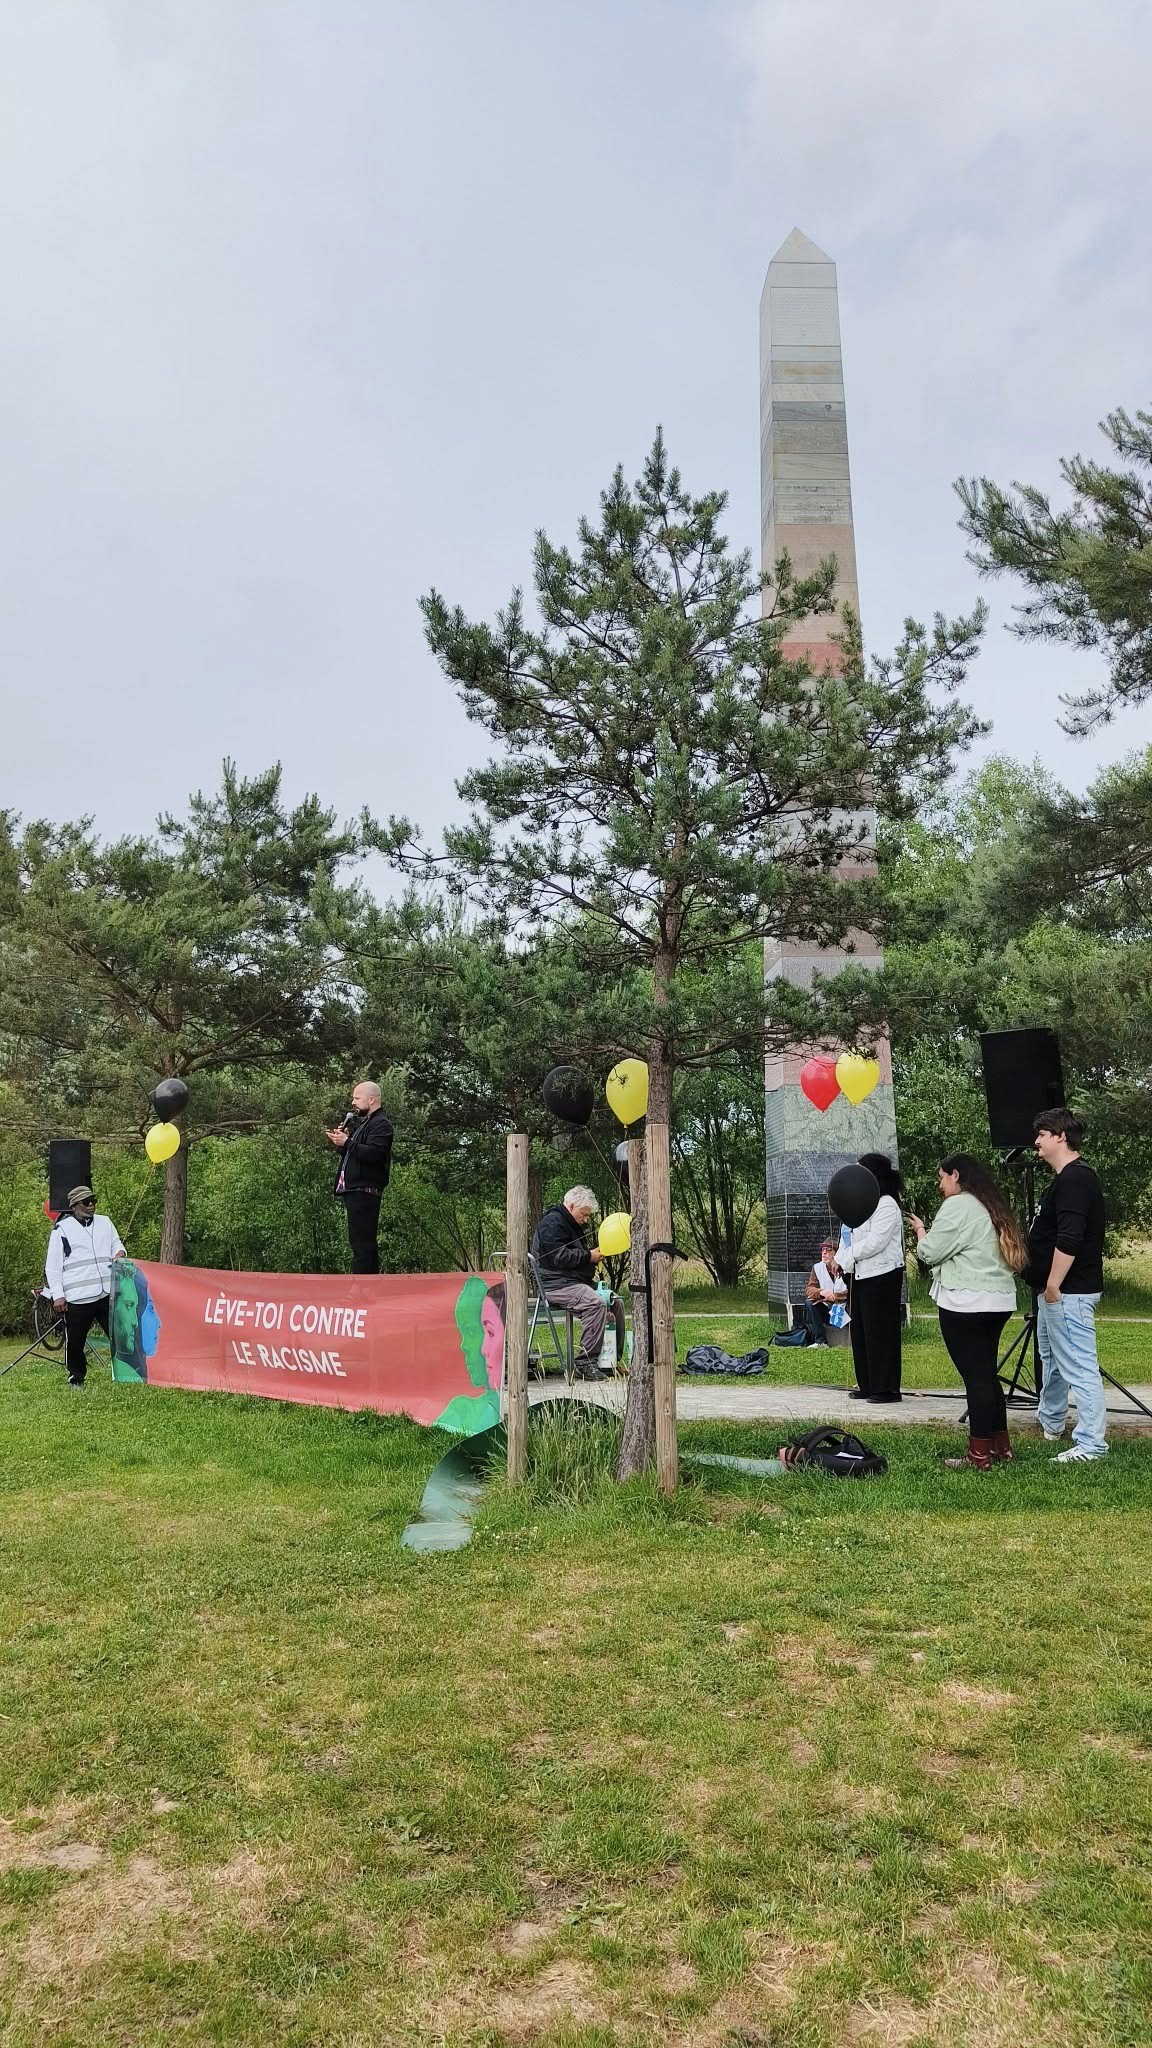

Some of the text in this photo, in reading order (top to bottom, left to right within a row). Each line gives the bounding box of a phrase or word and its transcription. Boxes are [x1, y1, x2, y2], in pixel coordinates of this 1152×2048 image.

[204, 1291, 367, 1338] LÈVE-TOI CONTRE
[231, 1340, 347, 1377] LE RACISME
